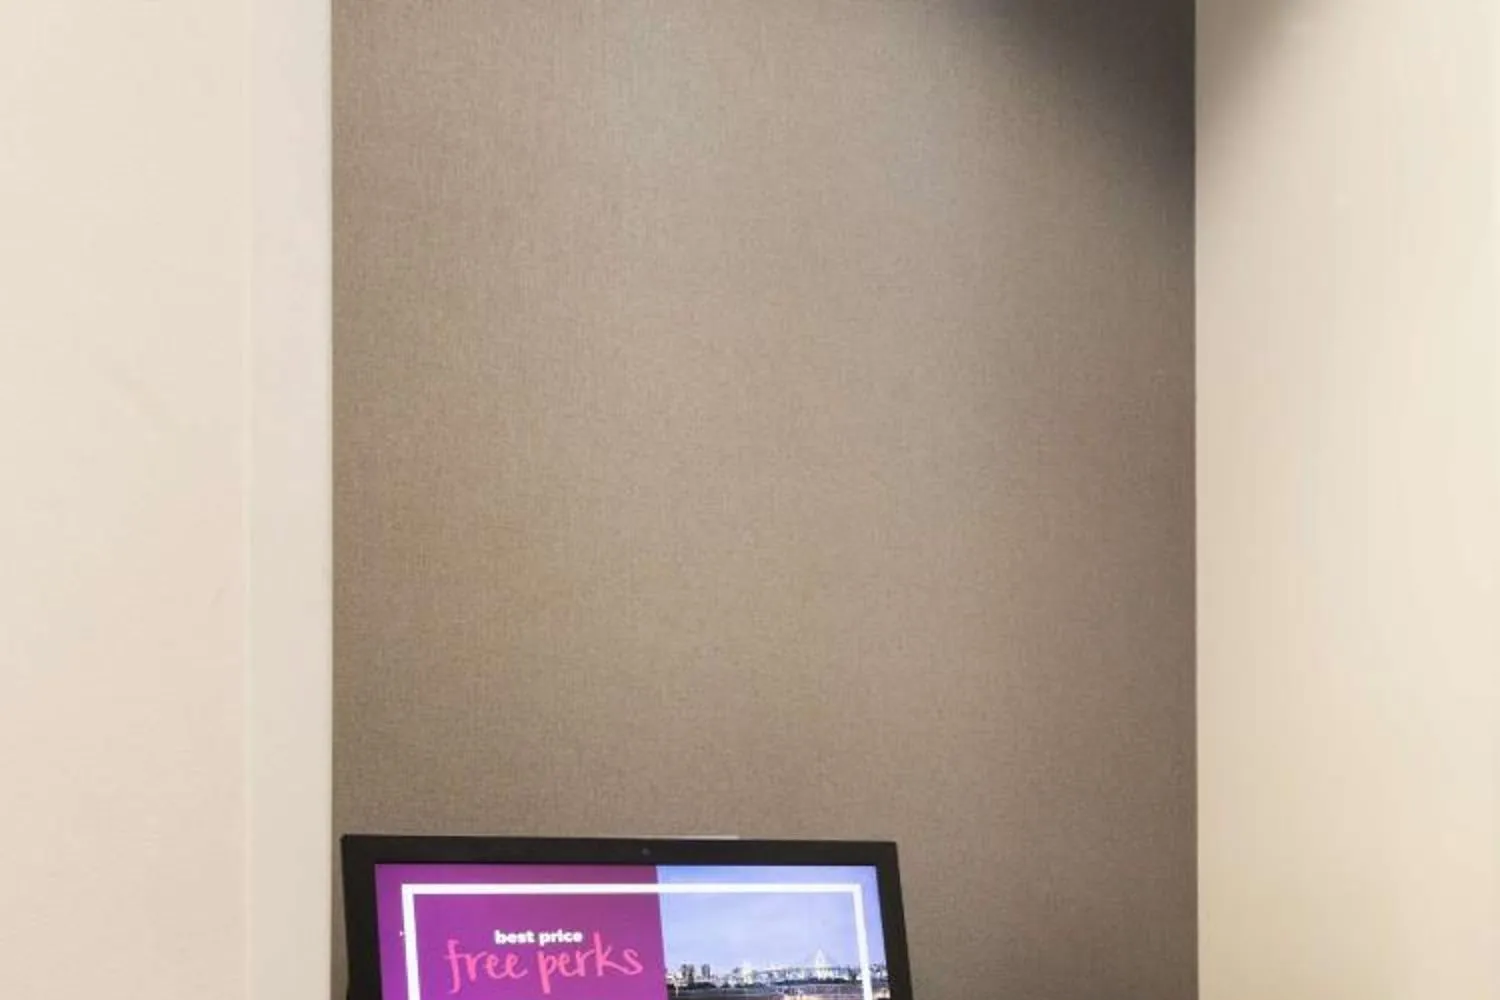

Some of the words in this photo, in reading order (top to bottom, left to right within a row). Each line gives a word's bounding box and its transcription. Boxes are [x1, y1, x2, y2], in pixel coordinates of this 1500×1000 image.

[494, 929, 535, 945] best
[539, 929, 583, 946] price
[443, 938, 528, 994] free
[536, 930, 644, 994] perks
